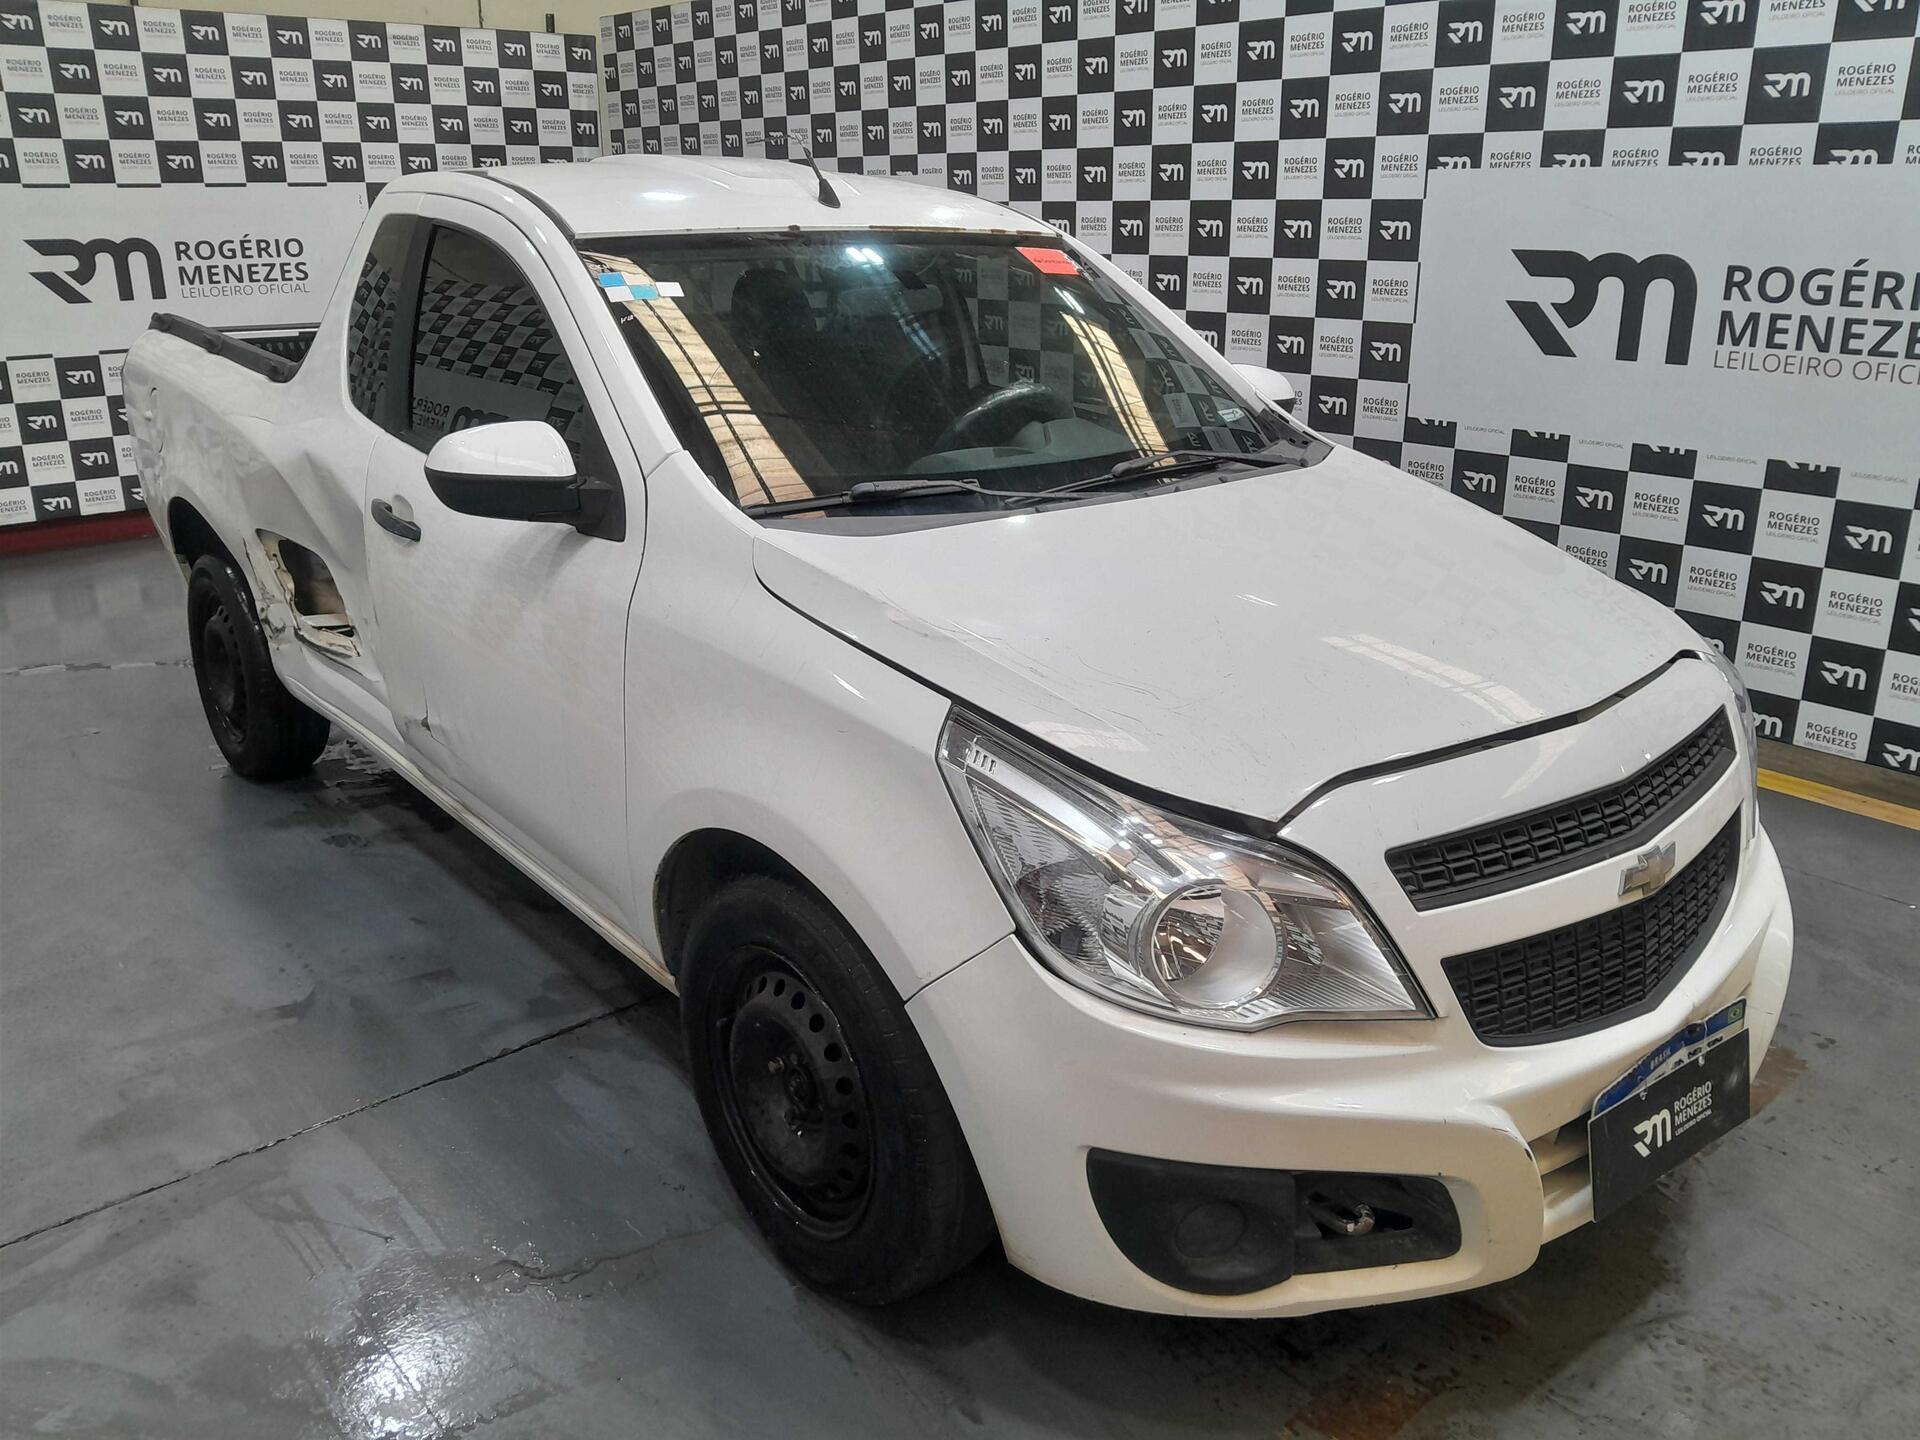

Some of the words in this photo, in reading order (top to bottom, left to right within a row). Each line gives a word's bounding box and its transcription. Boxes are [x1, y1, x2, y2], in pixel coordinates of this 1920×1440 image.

[1502, 10, 1546, 23] ROGÉRIO
[1627, 10, 1677, 23] MENEZES
[1390, 21, 1429, 33] ROGÉRIO
[1502, 21, 1546, 33] MENEZES
[1290, 32, 1325, 43] ROGÉRIO
[1390, 31, 1429, 42] MENEZES
[1201, 41, 1232, 51] ROGÉRIO
[1290, 41, 1325, 51] MENEZES
[1201, 50, 1232, 59] MENEZES
[1838, 62, 1898, 76] ROGÉRIO
[1688, 71, 1740, 83] ROGÉRIO
[1836, 75, 1896, 87] MENEZES
[1556, 78, 1602, 90] ROGÉRIO
[1686, 83, 1738, 94] MENEZES
[1439, 85, 1480, 96] ROGÉRIO
[1555, 89, 1601, 100] MENEZES
[1242, 98, 1274, 107] ROGÉRIO
[1335, 92, 1371, 102] ROGÉRIO
[1439, 95, 1479, 105] MENEZES
[1242, 107, 1274, 116] MENEZES
[1335, 101, 1371, 110] MENEZES
[1612, 148, 1659, 159] ROGÉRIO
[1749, 146, 1804, 157] ROGÉRIO
[1197, 159, 1227, 167] ROGÉRIO
[1284, 156, 1318, 165] ROGÉRIO
[1381, 153, 1419, 163] ROGÉRIO
[1381, 164, 1418, 172] MENEZES
[1237, 216, 1268, 224] ROGÉRIO
[1328, 216, 1363, 225] ROGÉRIO
[174, 234, 304, 262] ROGÉRIO
[178, 262, 309, 286] MENEZES
[1278, 275, 1310, 284] ROGÉRIO
[1277, 284, 1310, 292] MENEZES
[1372, 279, 1408, 288] ROGÉRIO
[1722, 258, 1920, 311] ROGÉRI
[181, 286, 254, 299] LEILOEIRO
[258, 283, 311, 295] OFICIAL
[1372, 288, 1408, 296] MENEZES
[1232, 329, 1262, 338] ROGÉRIO
[1716, 310, 1920, 360] MENEZE
[1232, 337, 1262, 346] MENEZES
[1320, 335, 1354, 345] ROGÉRIO
[1319, 344, 1354, 353] MENEZES
[1713, 350, 1843, 378] LEILOEIRO
[1852, 360, 1920, 385] OFIC
[1363, 397, 1399, 408] ROGÉRIO
[1363, 405, 1398, 416] MENEZES
[1408, 460, 1445, 472] ROGÉRIO
[1515, 475, 1556, 488] ROGÉRIO
[1514, 484, 1556, 497] MENEZES
[1634, 492, 1681, 506] ROGÉRIO
[1633, 501, 1680, 515] MENEZES
[1768, 510, 1821, 526] ROGÉRIO
[1767, 520, 1820, 536] MENEZES
[1565, 544, 1608, 559] ROGÉRIO
[1689, 566, 1738, 582] ROGÉRIO
[1688, 575, 1737, 591] MENEZES
[1829, 590, 1884, 608] ROGÉRIO
[1828, 600, 1883, 617] MENEZES
[1747, 642, 1798, 660] ROGÉRIO
[1745, 652, 1796, 669] MENEZES
[1806, 721, 1859, 741] ROGÉRIO
[1804, 731, 1858, 751] MENEZES
[1674, 1080, 1712, 1113] ROGÉRIO
[1674, 1094, 1712, 1126] MENEZES
